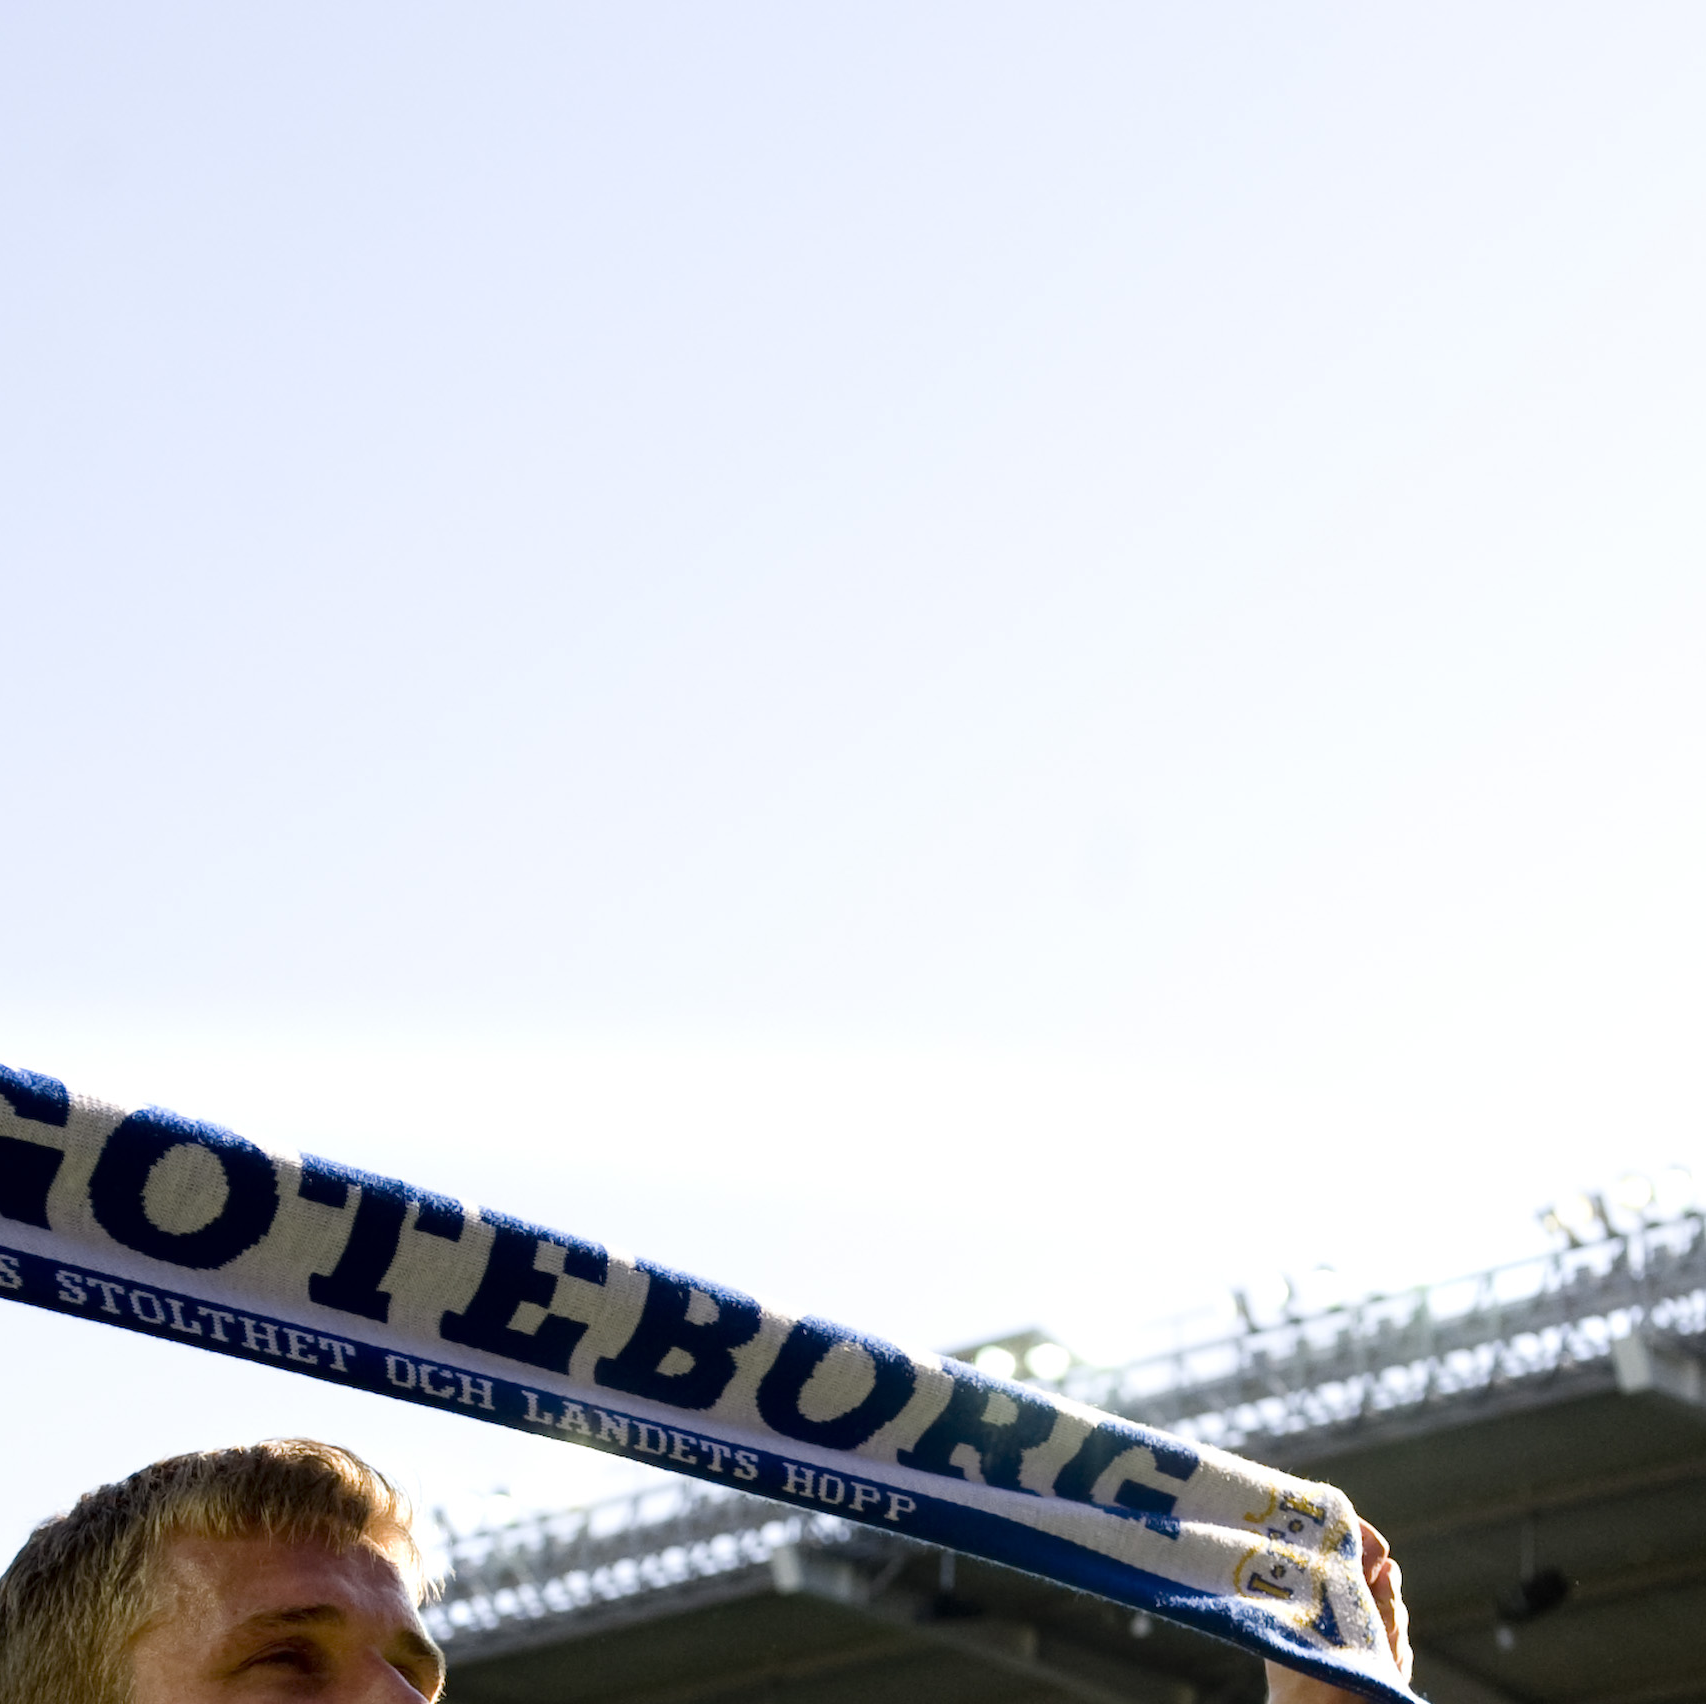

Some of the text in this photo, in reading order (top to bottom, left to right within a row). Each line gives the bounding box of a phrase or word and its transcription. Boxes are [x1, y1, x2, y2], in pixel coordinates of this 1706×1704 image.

[56, 1270, 358, 1374] STOLTHET
[384, 1354, 495, 1411] OCH
[522, 1390, 760, 1481] LANDETS
[781, 1465, 918, 1523] HOPP
